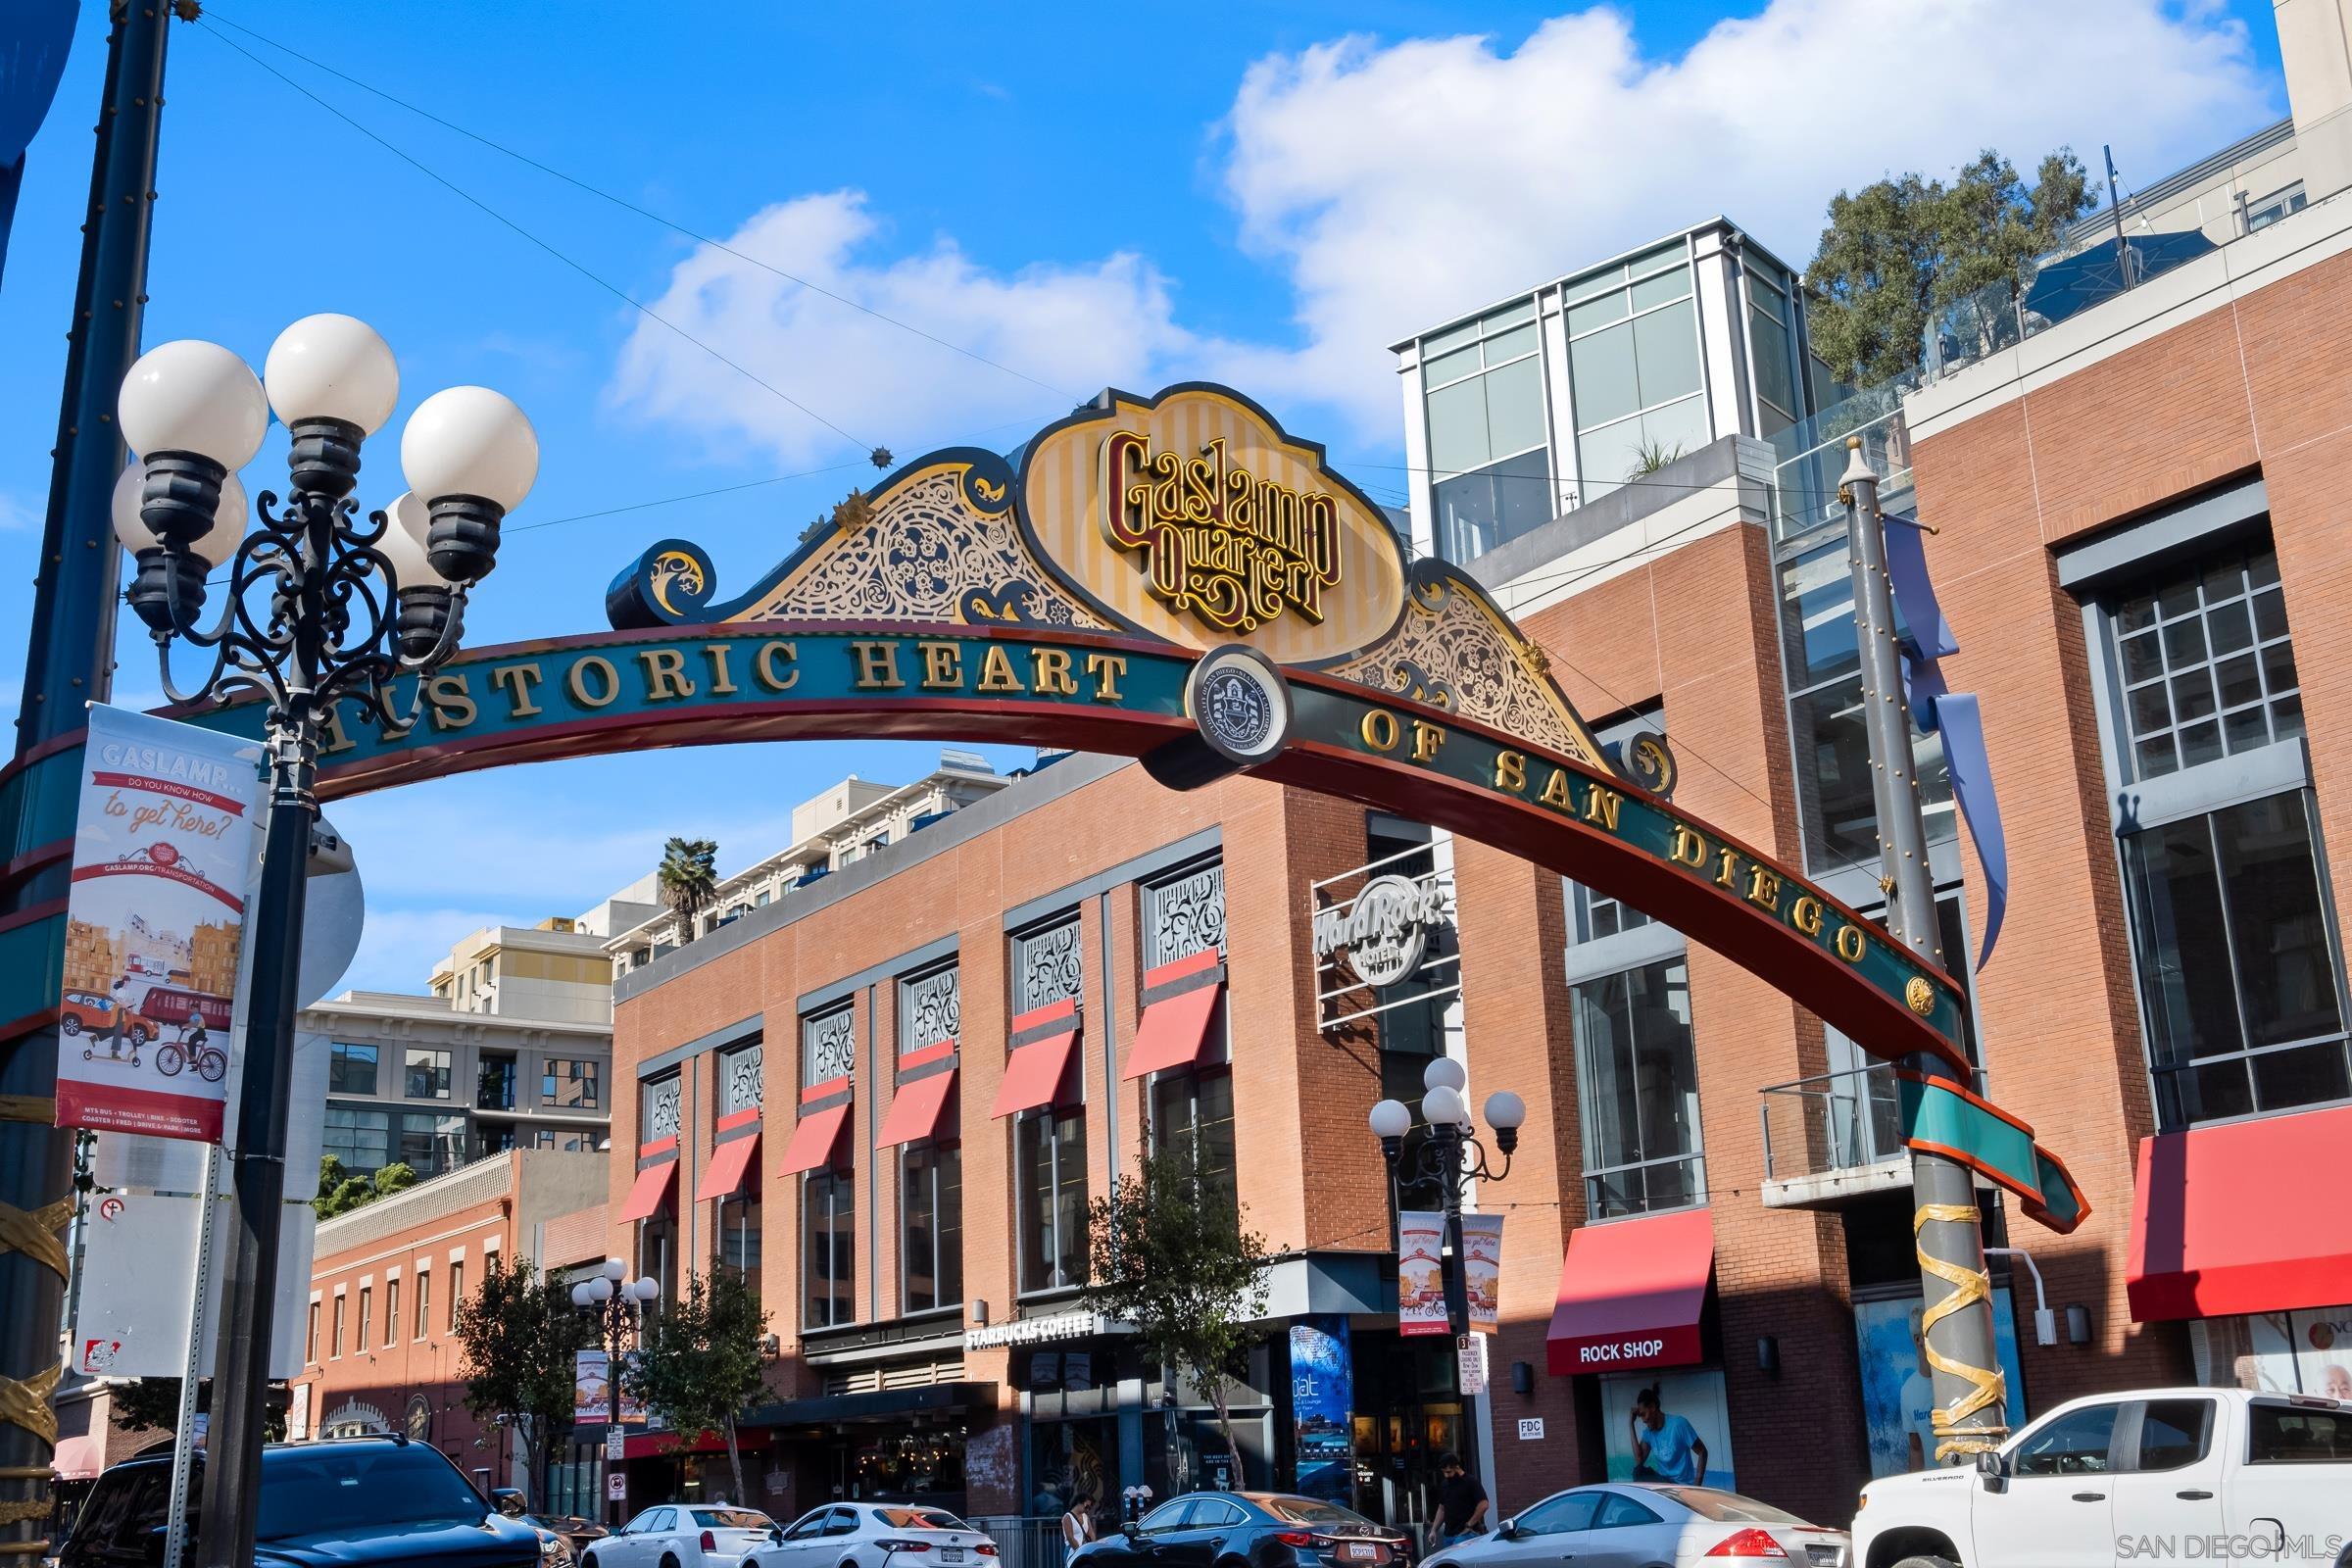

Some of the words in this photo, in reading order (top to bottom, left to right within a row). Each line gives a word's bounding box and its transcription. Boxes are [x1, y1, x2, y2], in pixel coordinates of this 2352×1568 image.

[1099, 430, 1343, 623] Gaslamp
[1149, 521, 1314, 633] Quarter
[128, 777, 142, 787] DO
[143, 779, 163, 790] YOU
[164, 783, 191, 797] KNOW
[192, 791, 215, 803] HOW
[851, 640, 1128, 702] HEART
[1361, 708, 1446, 763] OF
[1494, 749, 1625, 831] SAN
[1671, 823, 1867, 963] DIEGO
[105, 789, 128, 816] to
[129, 799, 170, 834] get
[170, 803, 233, 841] here?
[1312, 896, 1375, 955] Hard
[1375, 878, 1446, 939] Rock
[82, 1114, 111, 1124] COASTER
[119, 1110, 145, 1119] TROLLEY
[170, 1116, 198, 1125] SCOOTER
[965, 1320, 1038, 1348] STARBUCKS
[1039, 1313, 1094, 1337] COFFEE
[1460, 1339, 1466, 1348] 3
[1580, 1344, 1621, 1363] ROCK
[1623, 1339, 1663, 1359] SHOP
[1520, 1420, 1541, 1432] FDC
